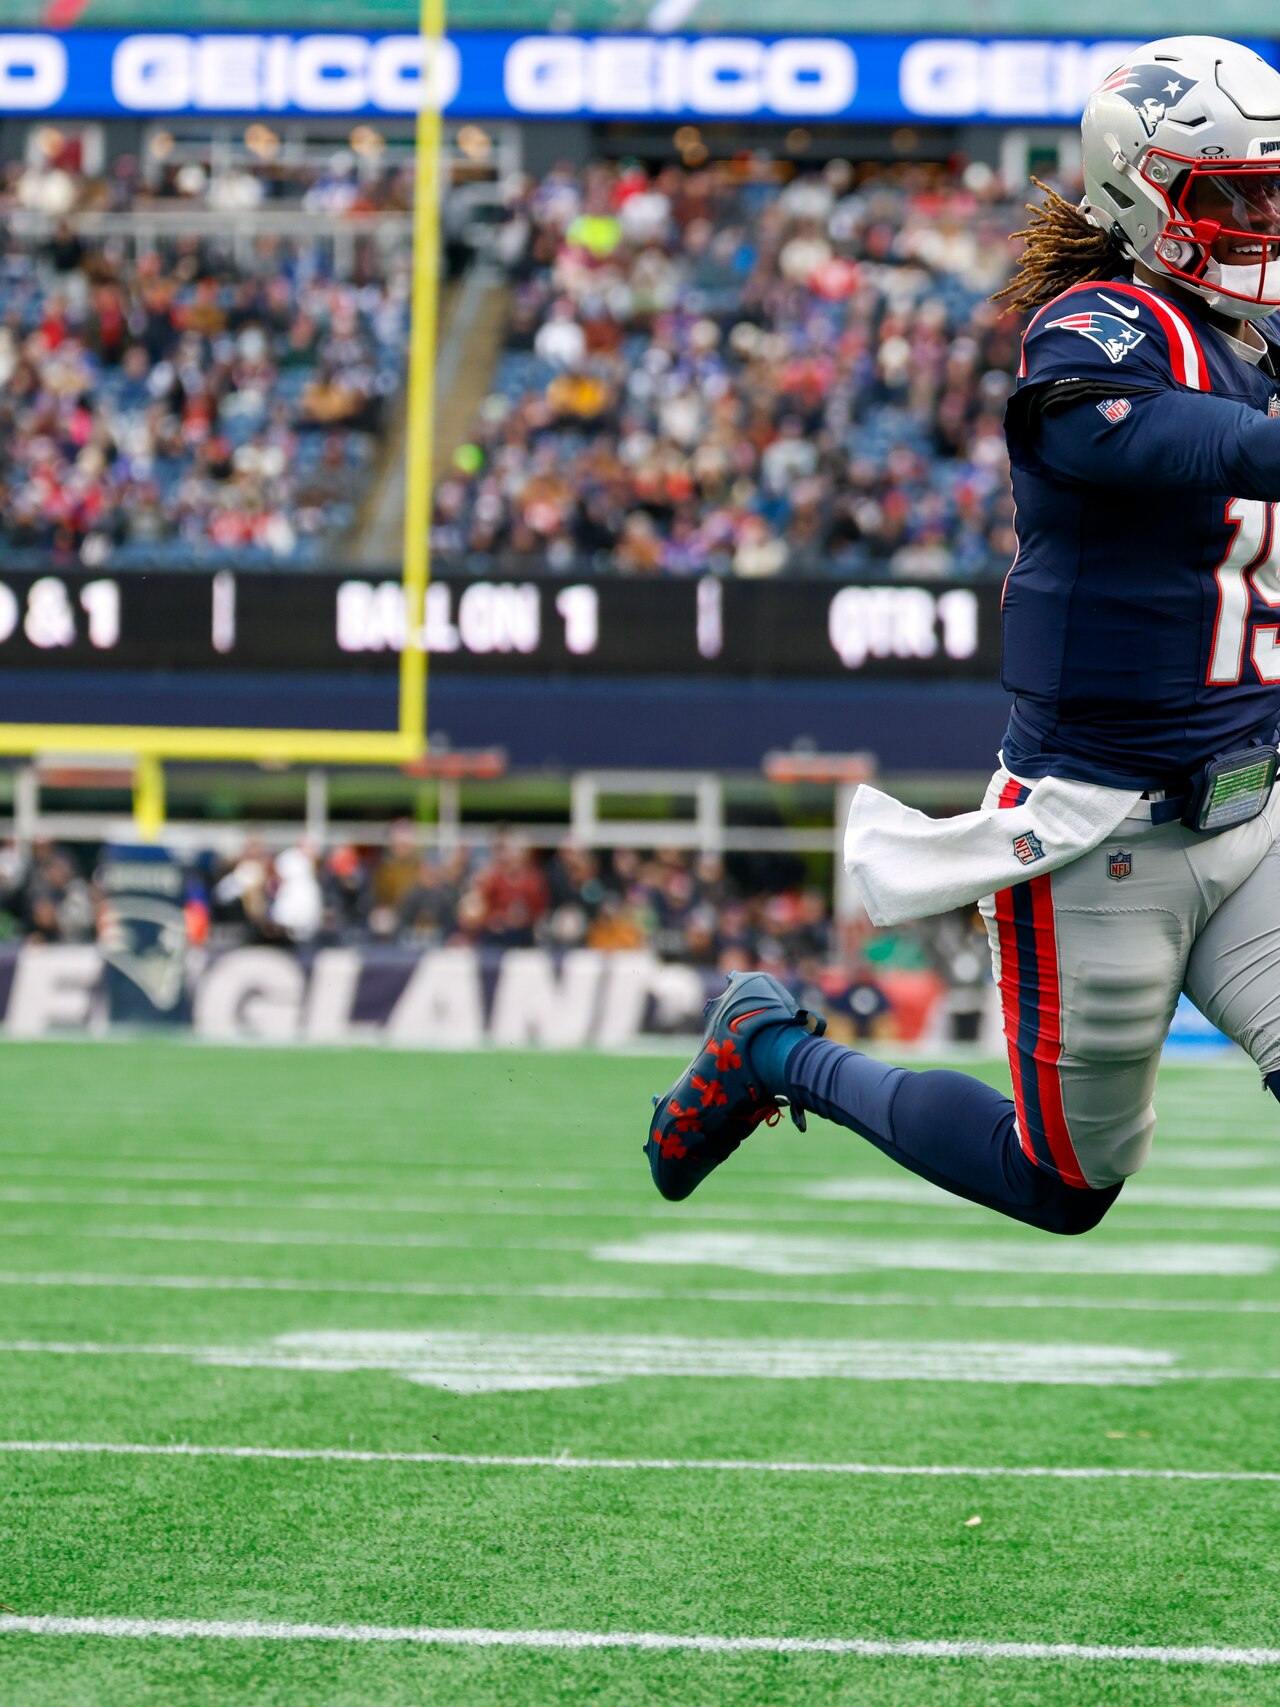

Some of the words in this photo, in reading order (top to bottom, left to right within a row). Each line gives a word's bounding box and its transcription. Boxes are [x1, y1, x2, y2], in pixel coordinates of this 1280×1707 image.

[112, 35, 461, 110] GEICO
[503, 37, 857, 114] GEICO
[1106, 401, 1128, 422] NFL
[80, 580, 119, 648] 1
[556, 584, 597, 654] 1
[938, 589, 978, 659] 1
[1015, 838, 1033, 863] NFL
[1111, 862, 1130, 876] NFL
